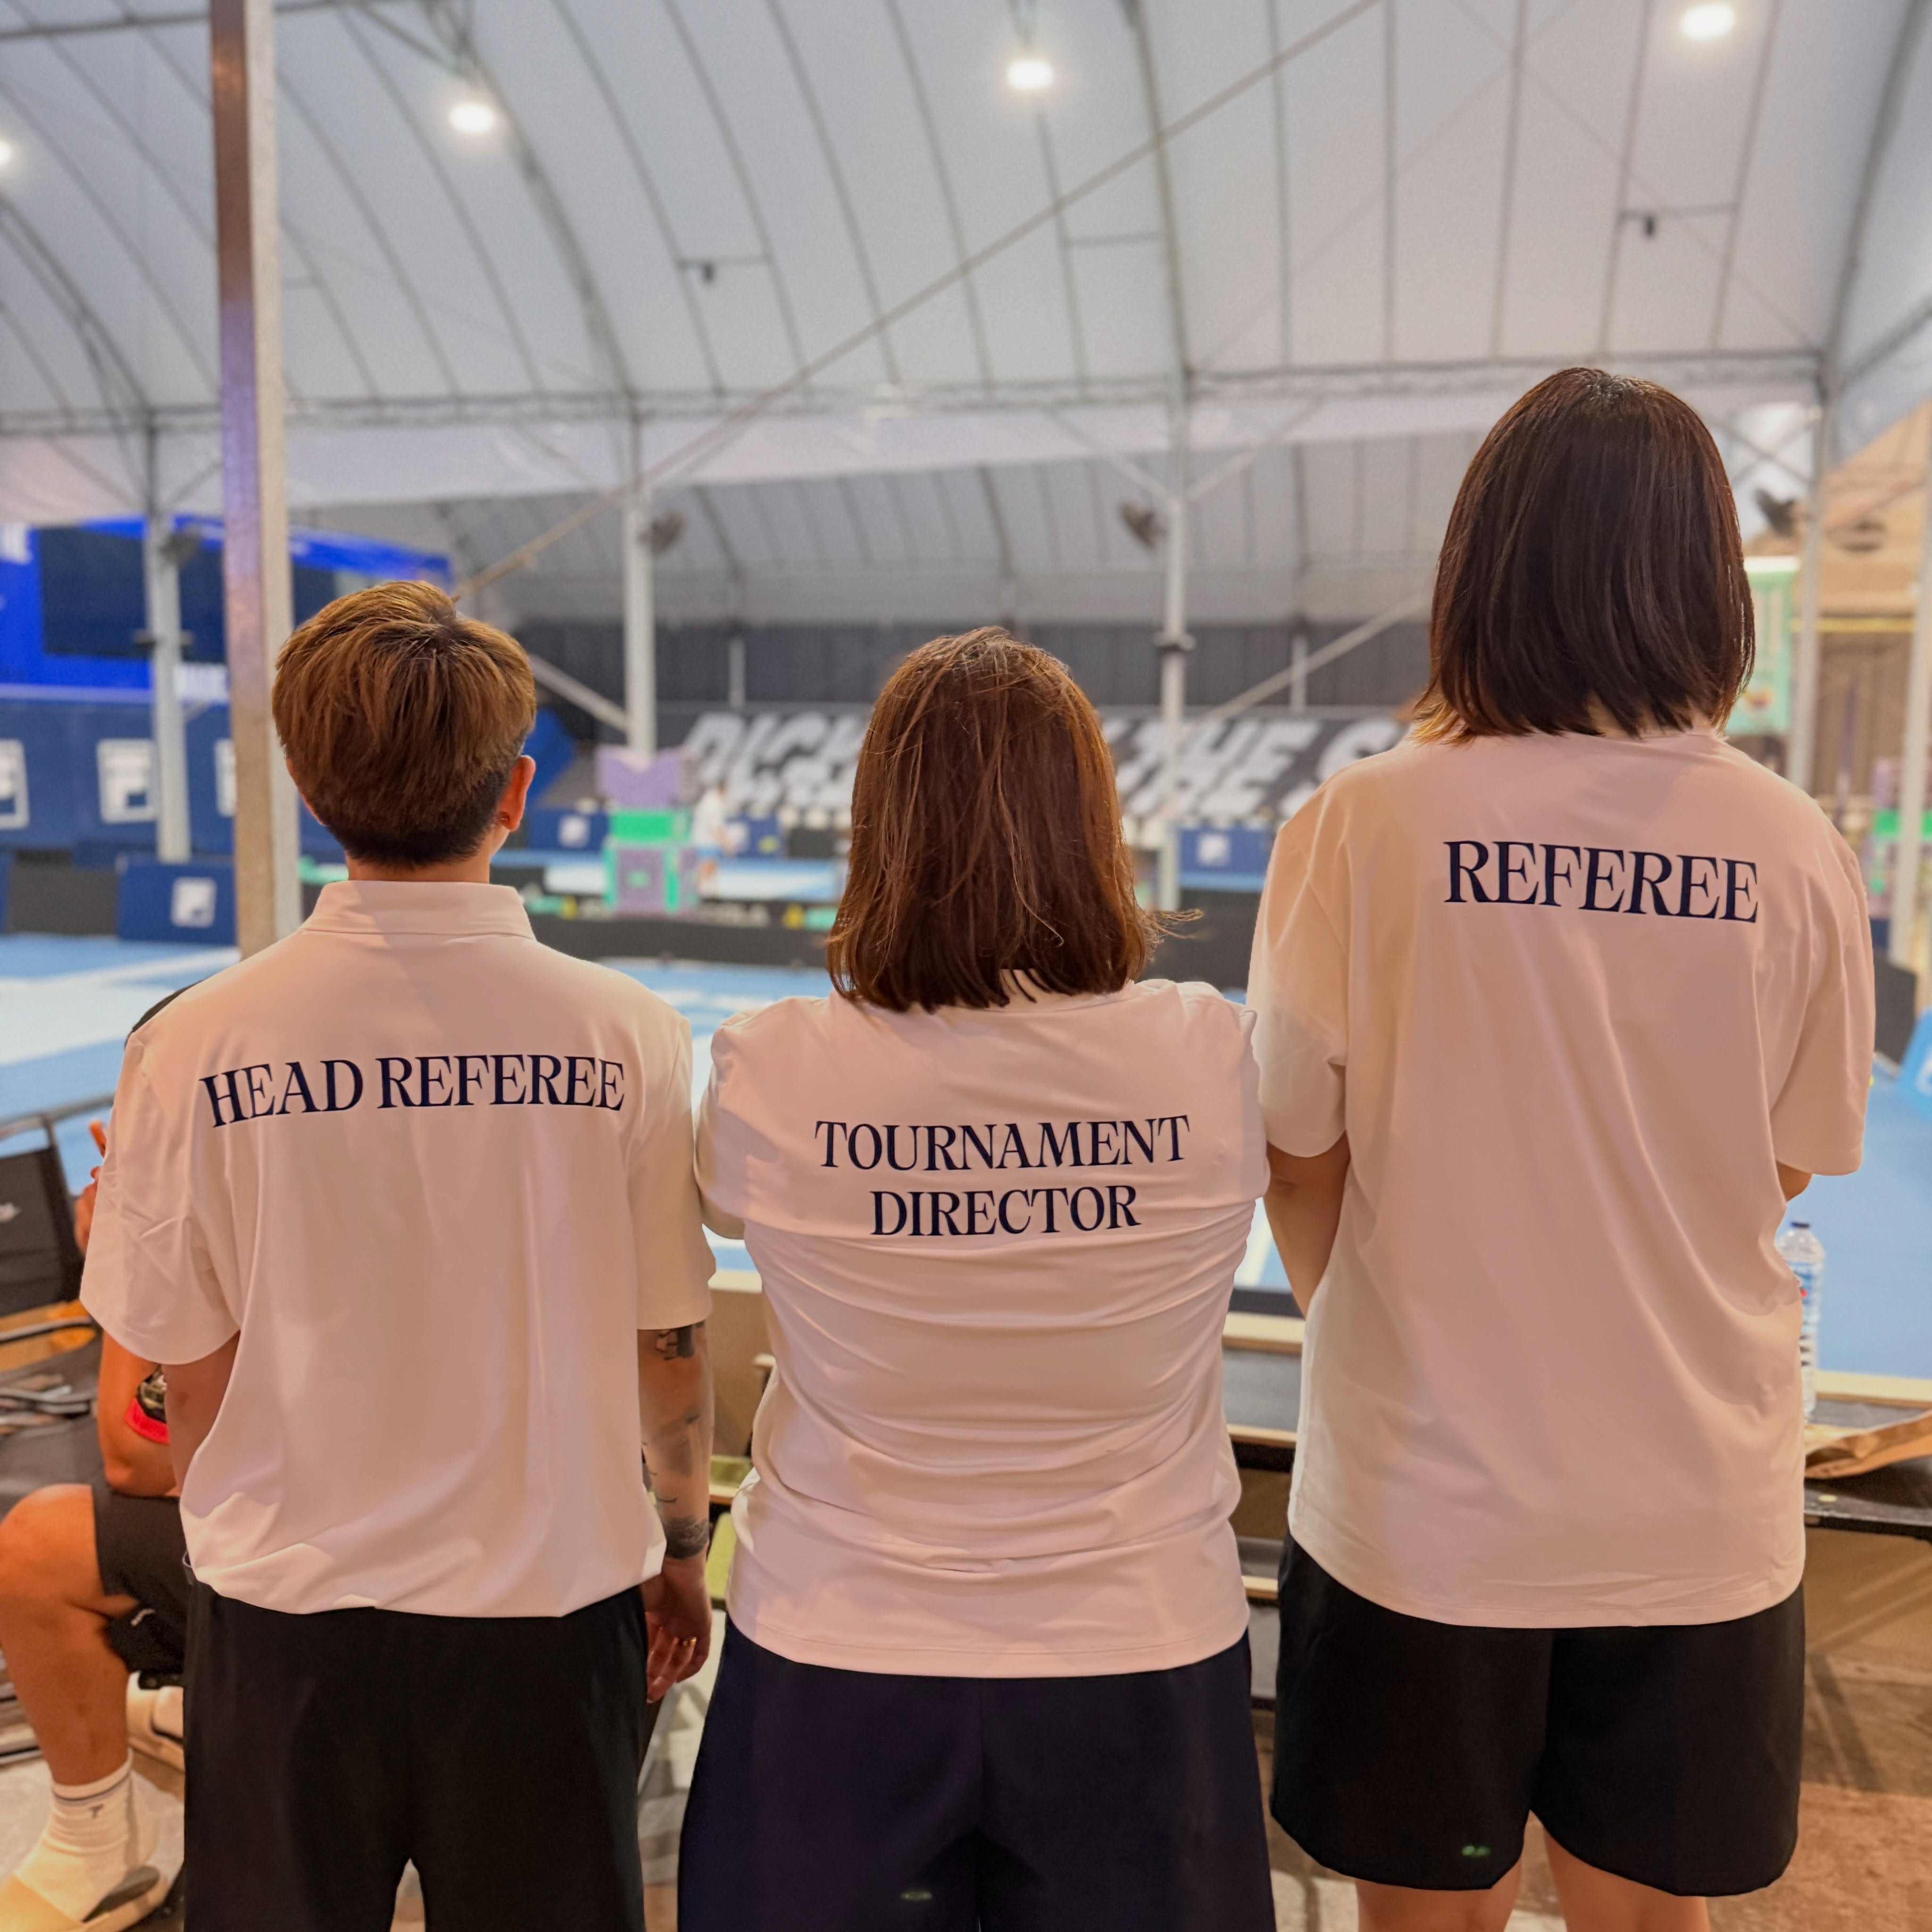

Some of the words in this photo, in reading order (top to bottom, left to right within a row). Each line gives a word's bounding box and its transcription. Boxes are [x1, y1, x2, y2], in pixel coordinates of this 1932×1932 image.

[1443, 840, 1758, 924] REFEREE
[199, 1059, 363, 1128] HEAD
[375, 1054, 625, 1111] REFEREE
[815, 1115, 1190, 1171] TOURNAMENT
[869, 1185, 1141, 1236] DIRECTOR
